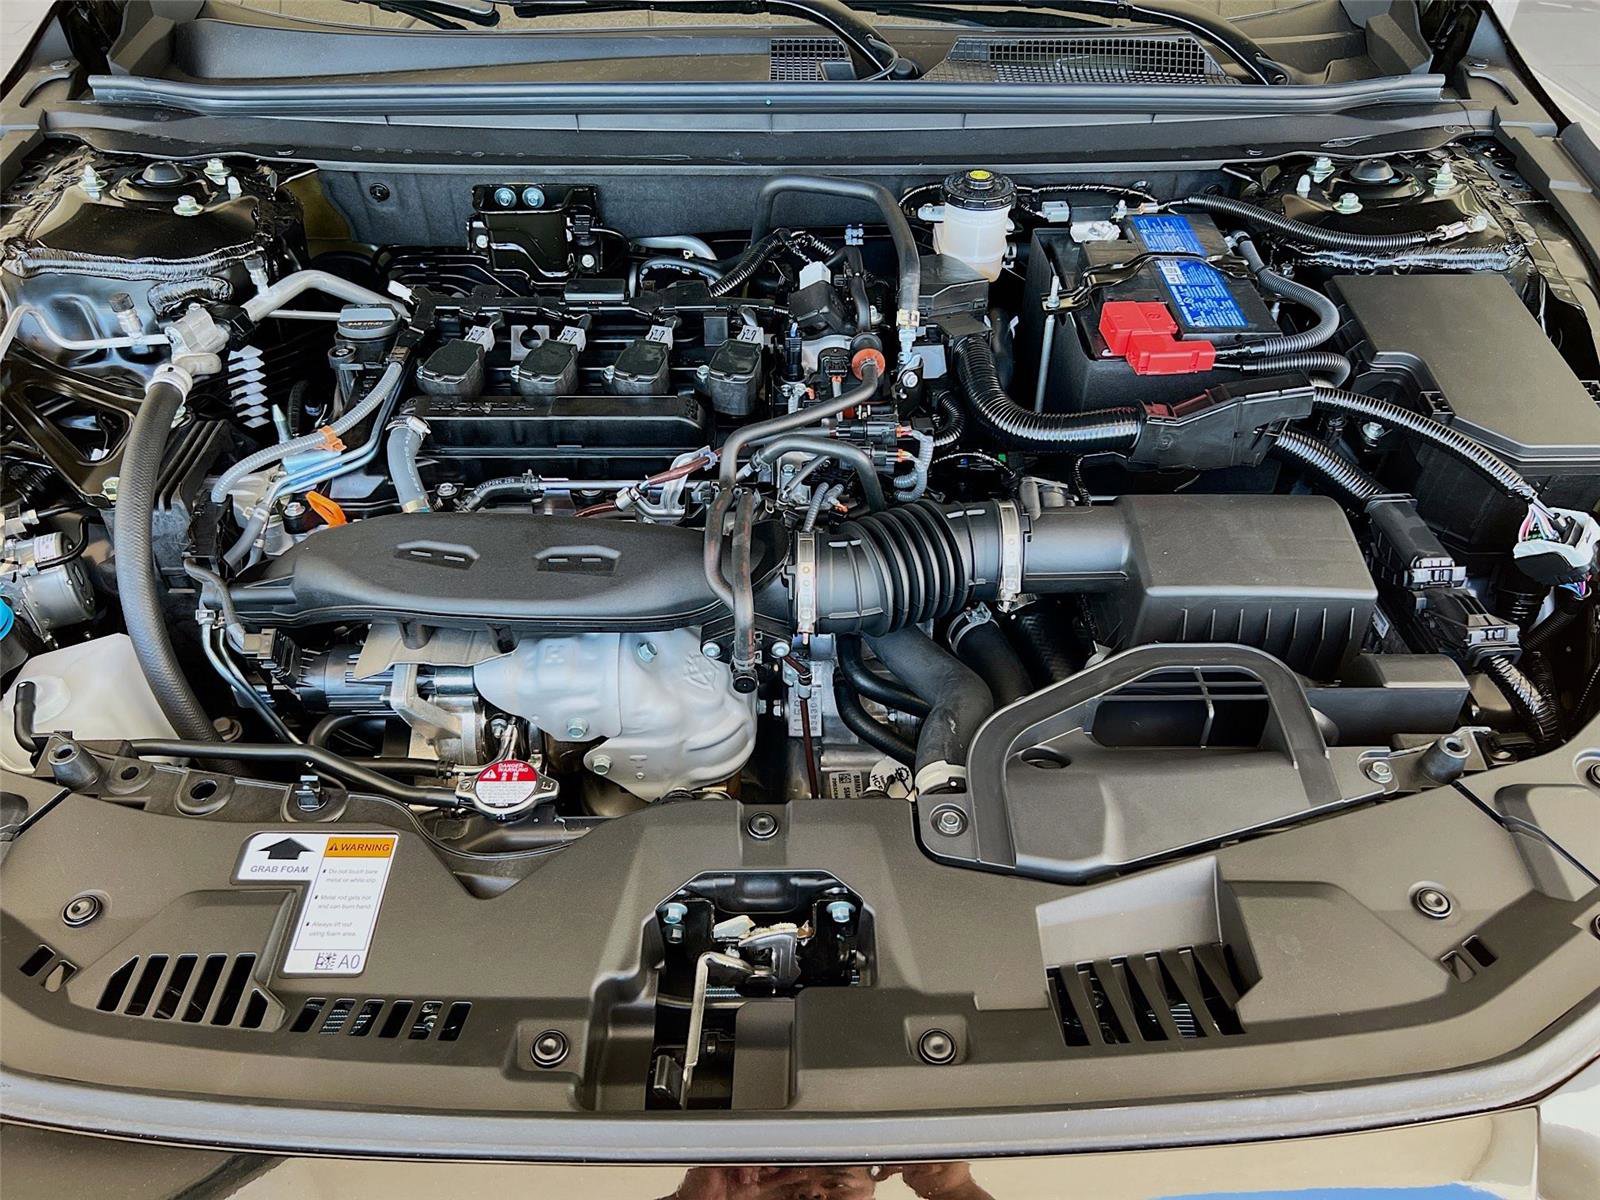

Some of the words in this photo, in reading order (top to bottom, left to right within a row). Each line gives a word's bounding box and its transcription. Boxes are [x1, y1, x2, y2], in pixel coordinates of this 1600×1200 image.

[341, 843, 390, 852] WARNING
[250, 865, 279, 873] GRAB
[280, 865, 310, 873] FOAM
